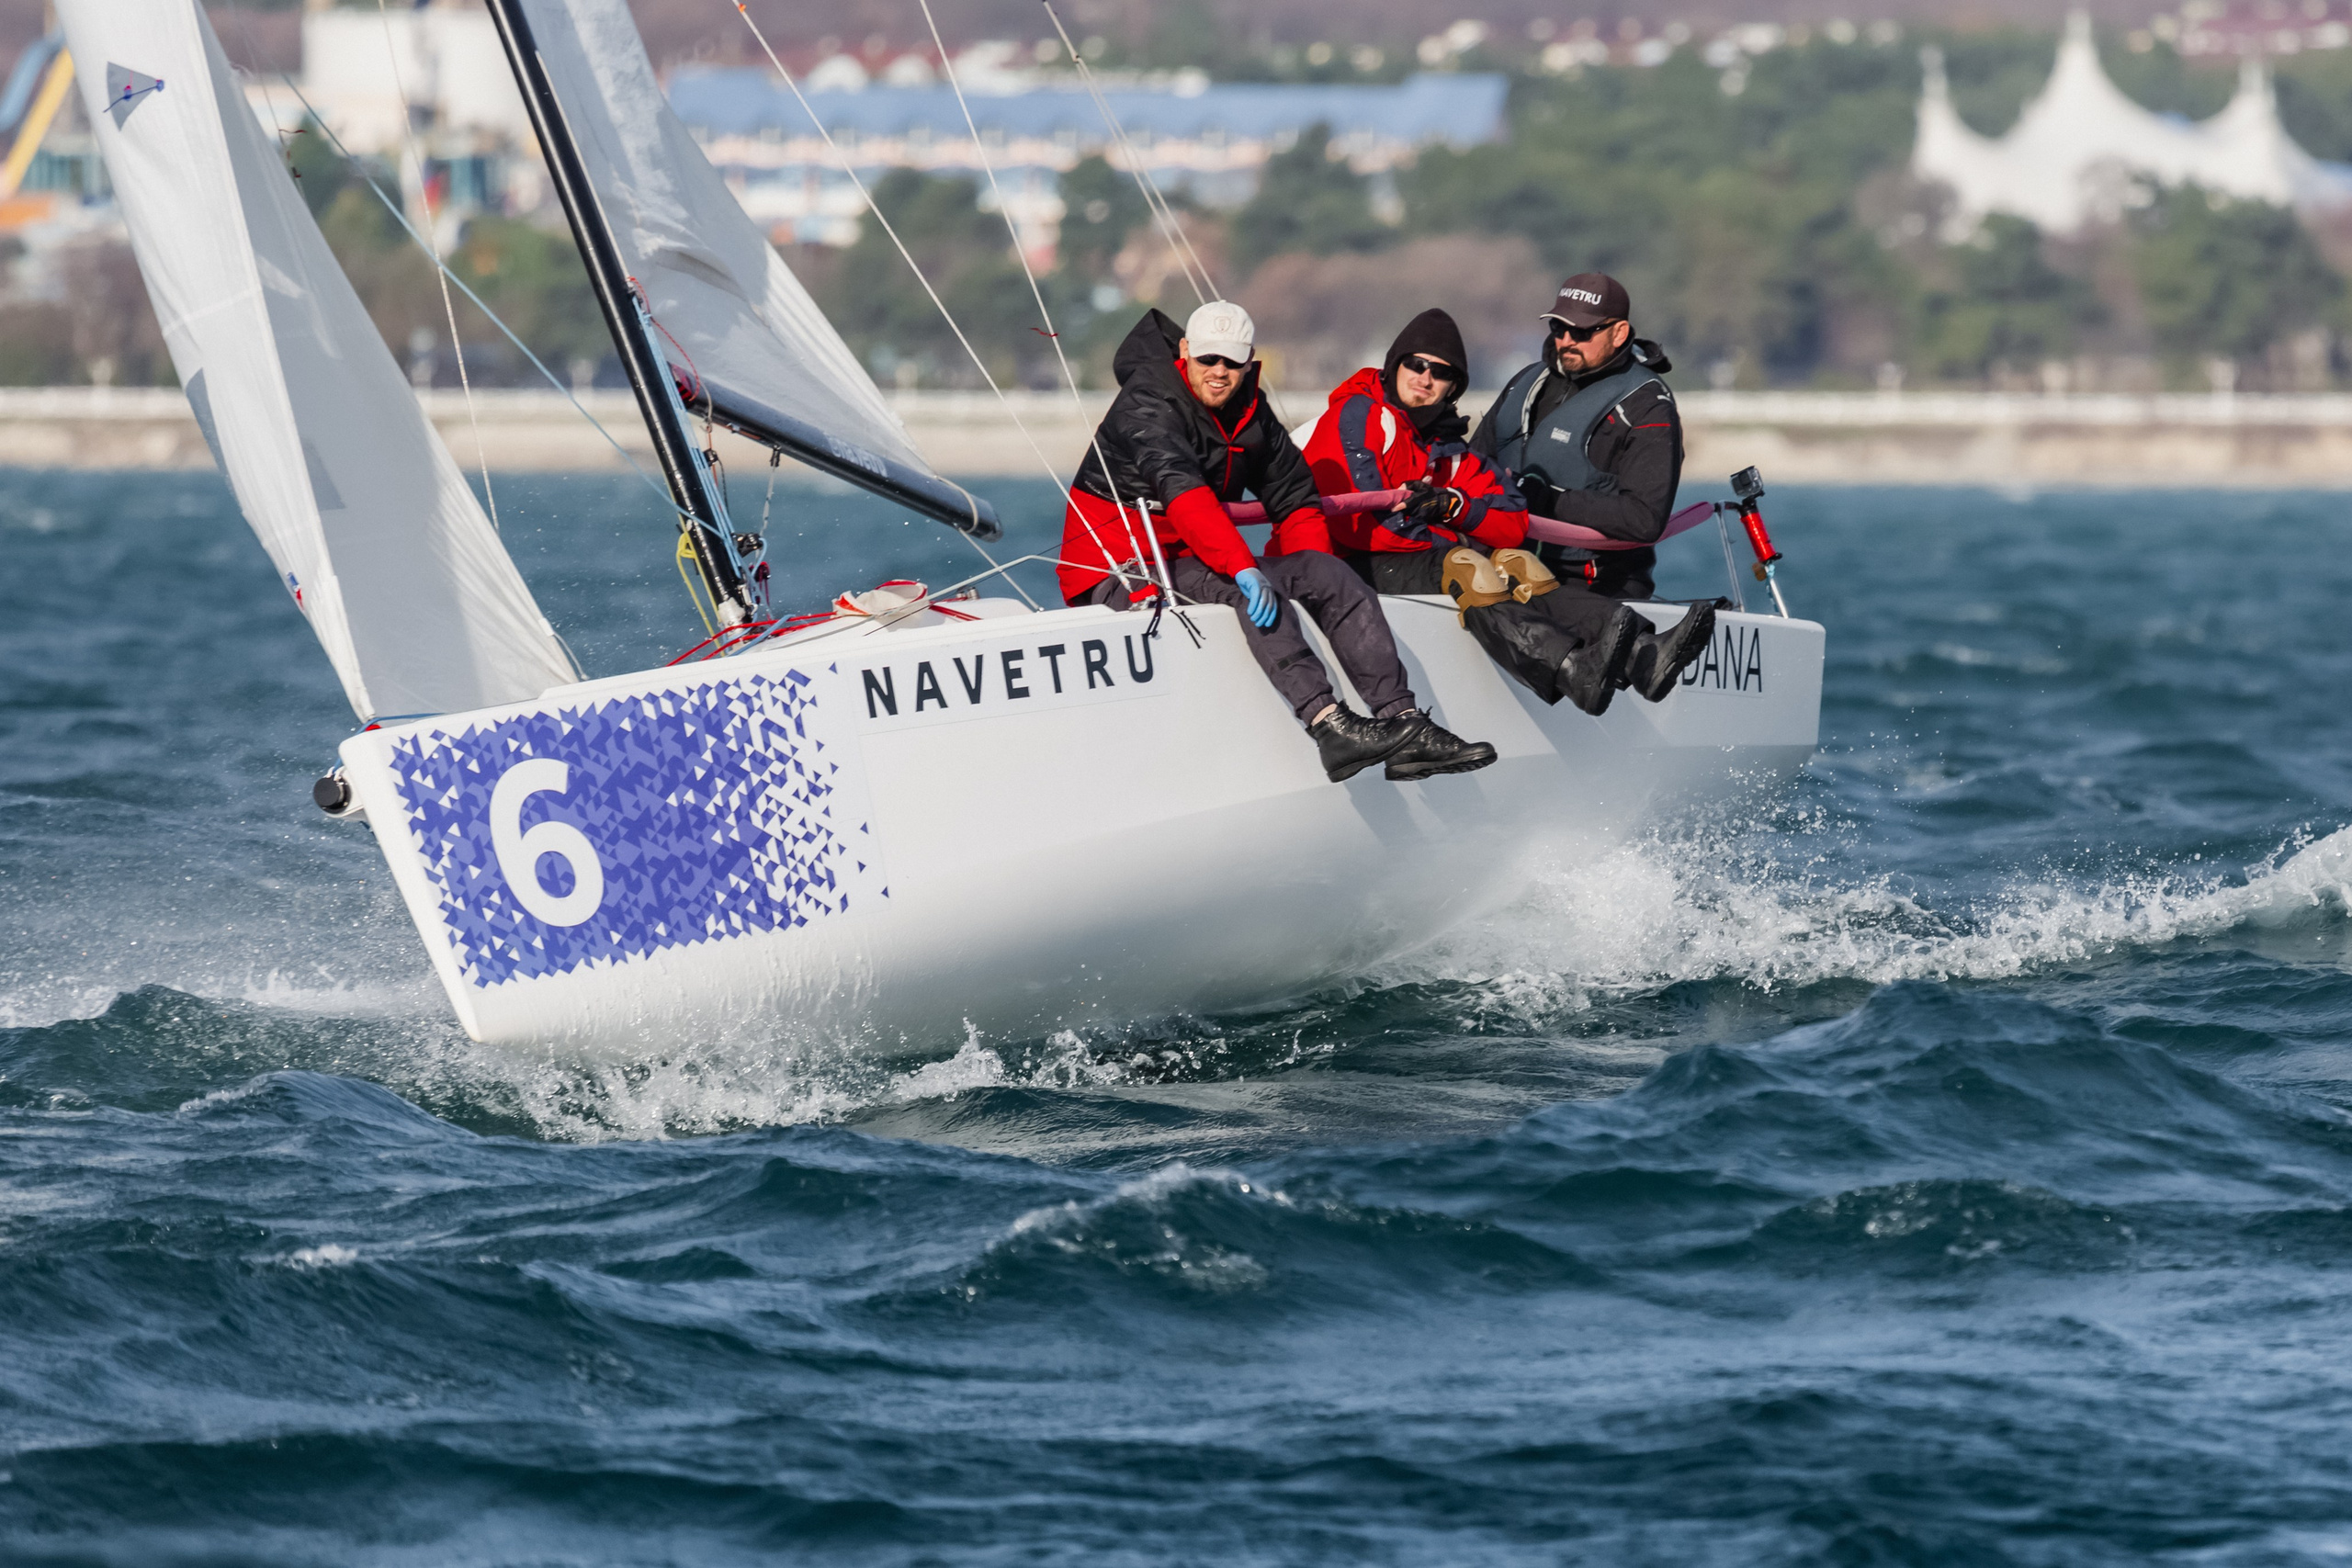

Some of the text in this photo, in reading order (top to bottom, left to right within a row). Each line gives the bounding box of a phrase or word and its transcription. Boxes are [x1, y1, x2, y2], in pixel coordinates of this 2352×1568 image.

[1559, 287, 1602, 305] NAVETRU
[862, 632, 1154, 718] NAVETRU
[490, 758, 605, 927] 6
